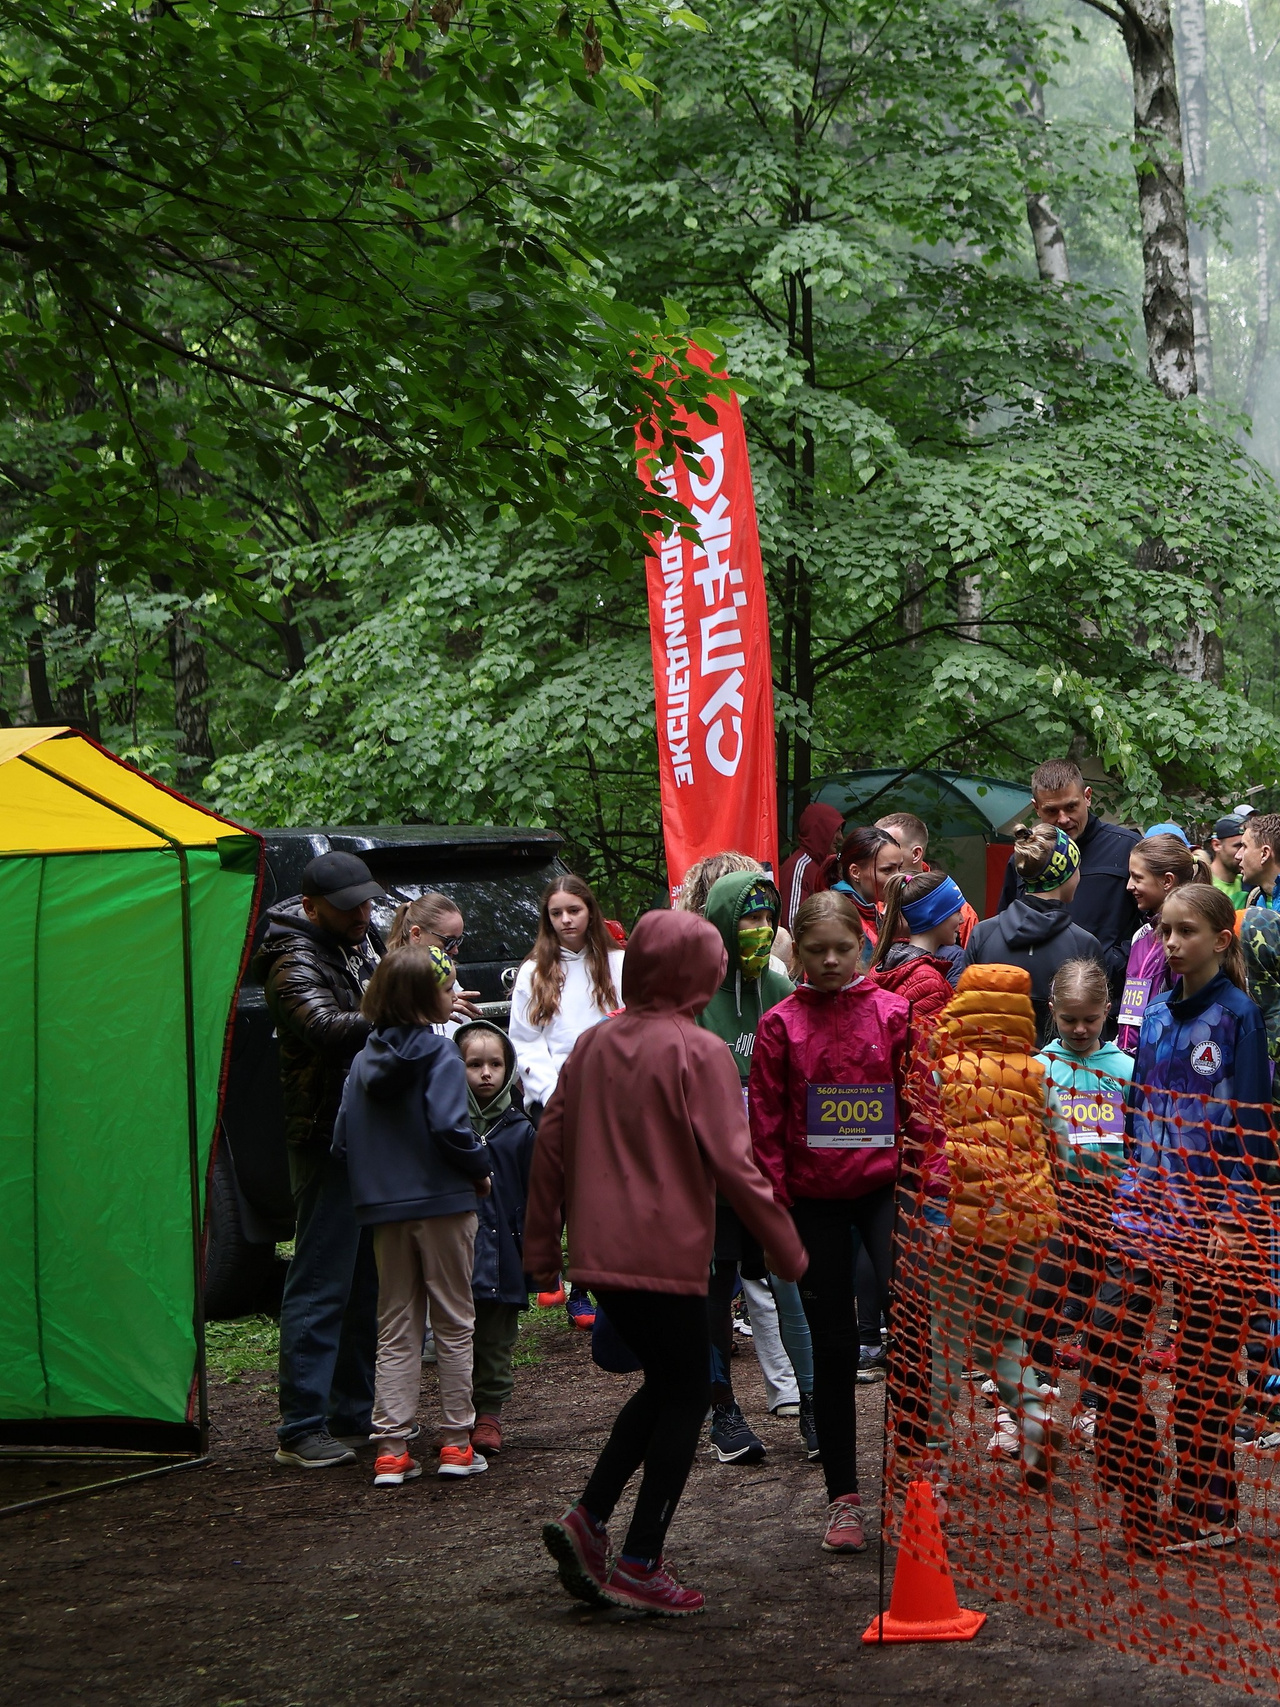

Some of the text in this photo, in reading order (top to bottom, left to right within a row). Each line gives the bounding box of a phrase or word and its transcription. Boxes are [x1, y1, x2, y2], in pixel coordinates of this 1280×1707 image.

[1122, 989, 1144, 1007] 2115
[816, 1087, 838, 1095] 3600
[820, 1100, 884, 1122] 2003
[1061, 1103, 1115, 1123] 2008
[838, 1126, 866, 1135] Арина
